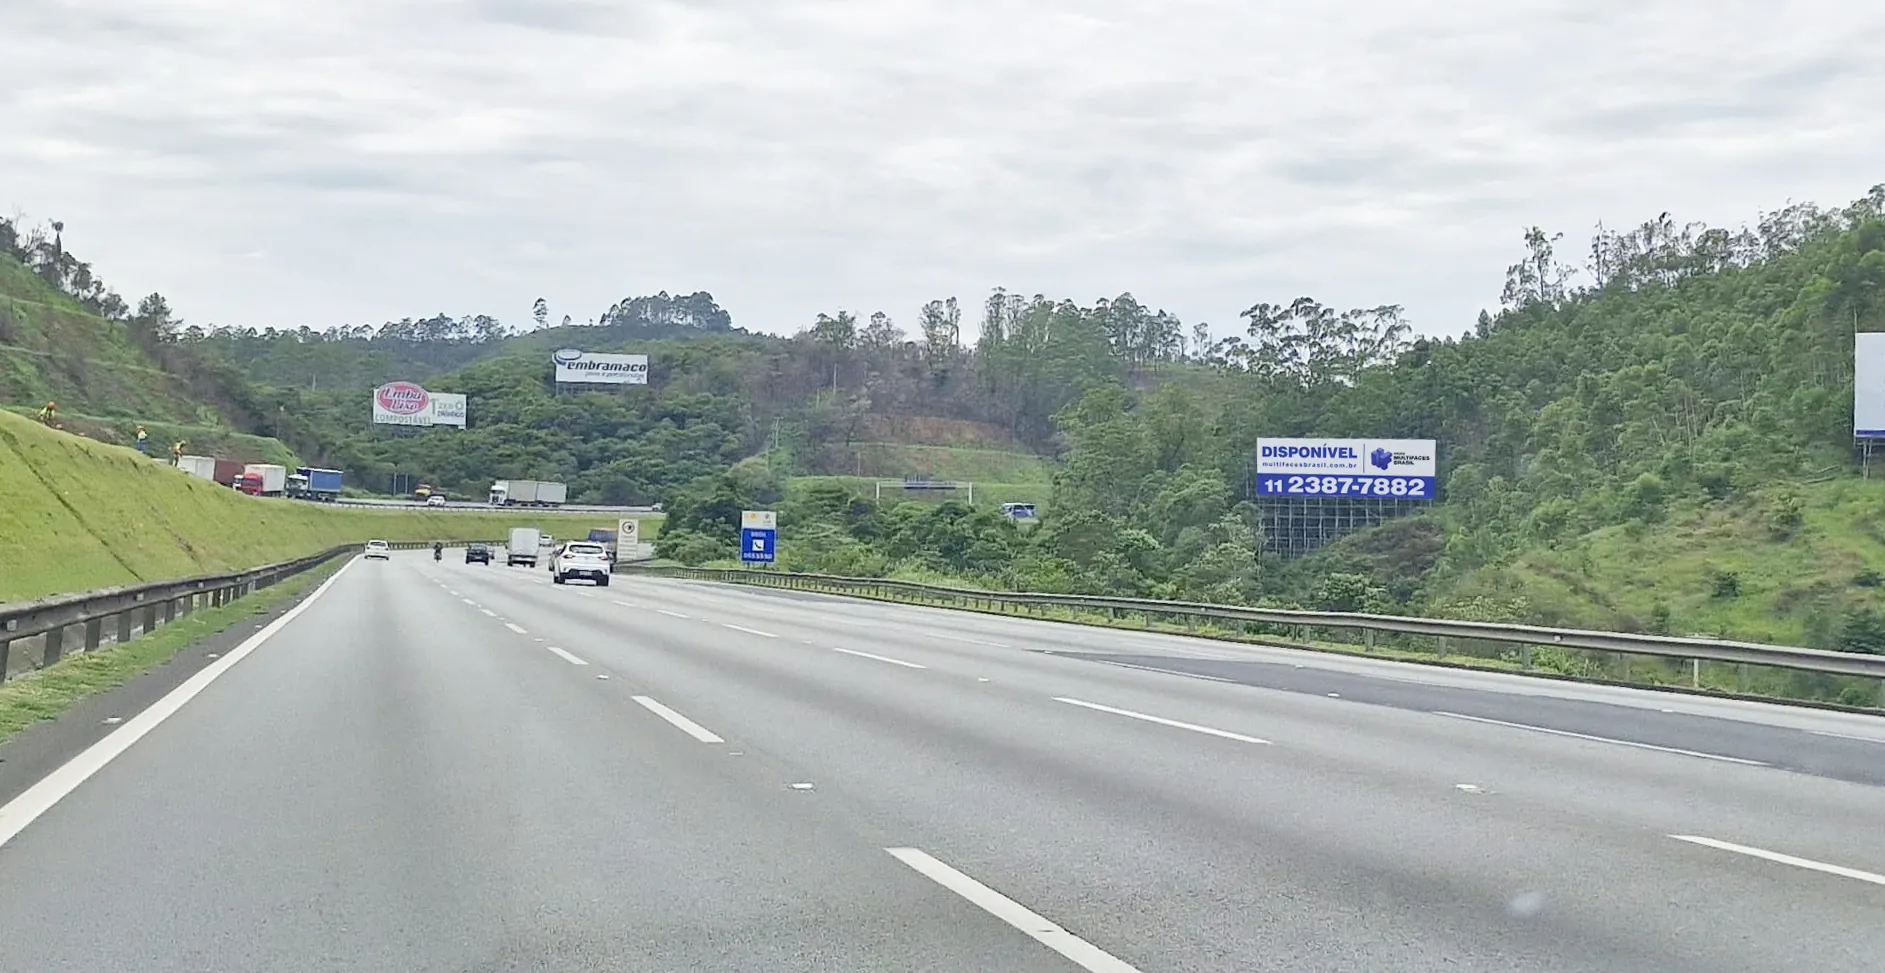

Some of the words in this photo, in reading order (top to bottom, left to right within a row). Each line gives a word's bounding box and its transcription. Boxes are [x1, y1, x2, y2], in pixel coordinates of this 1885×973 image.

[567, 360, 647, 372] embramaco
[1261, 443, 1358, 459] DISPONÍVEL
[1264, 479, 1282, 492] 11
[1288, 476, 1425, 496] 2387-7882
